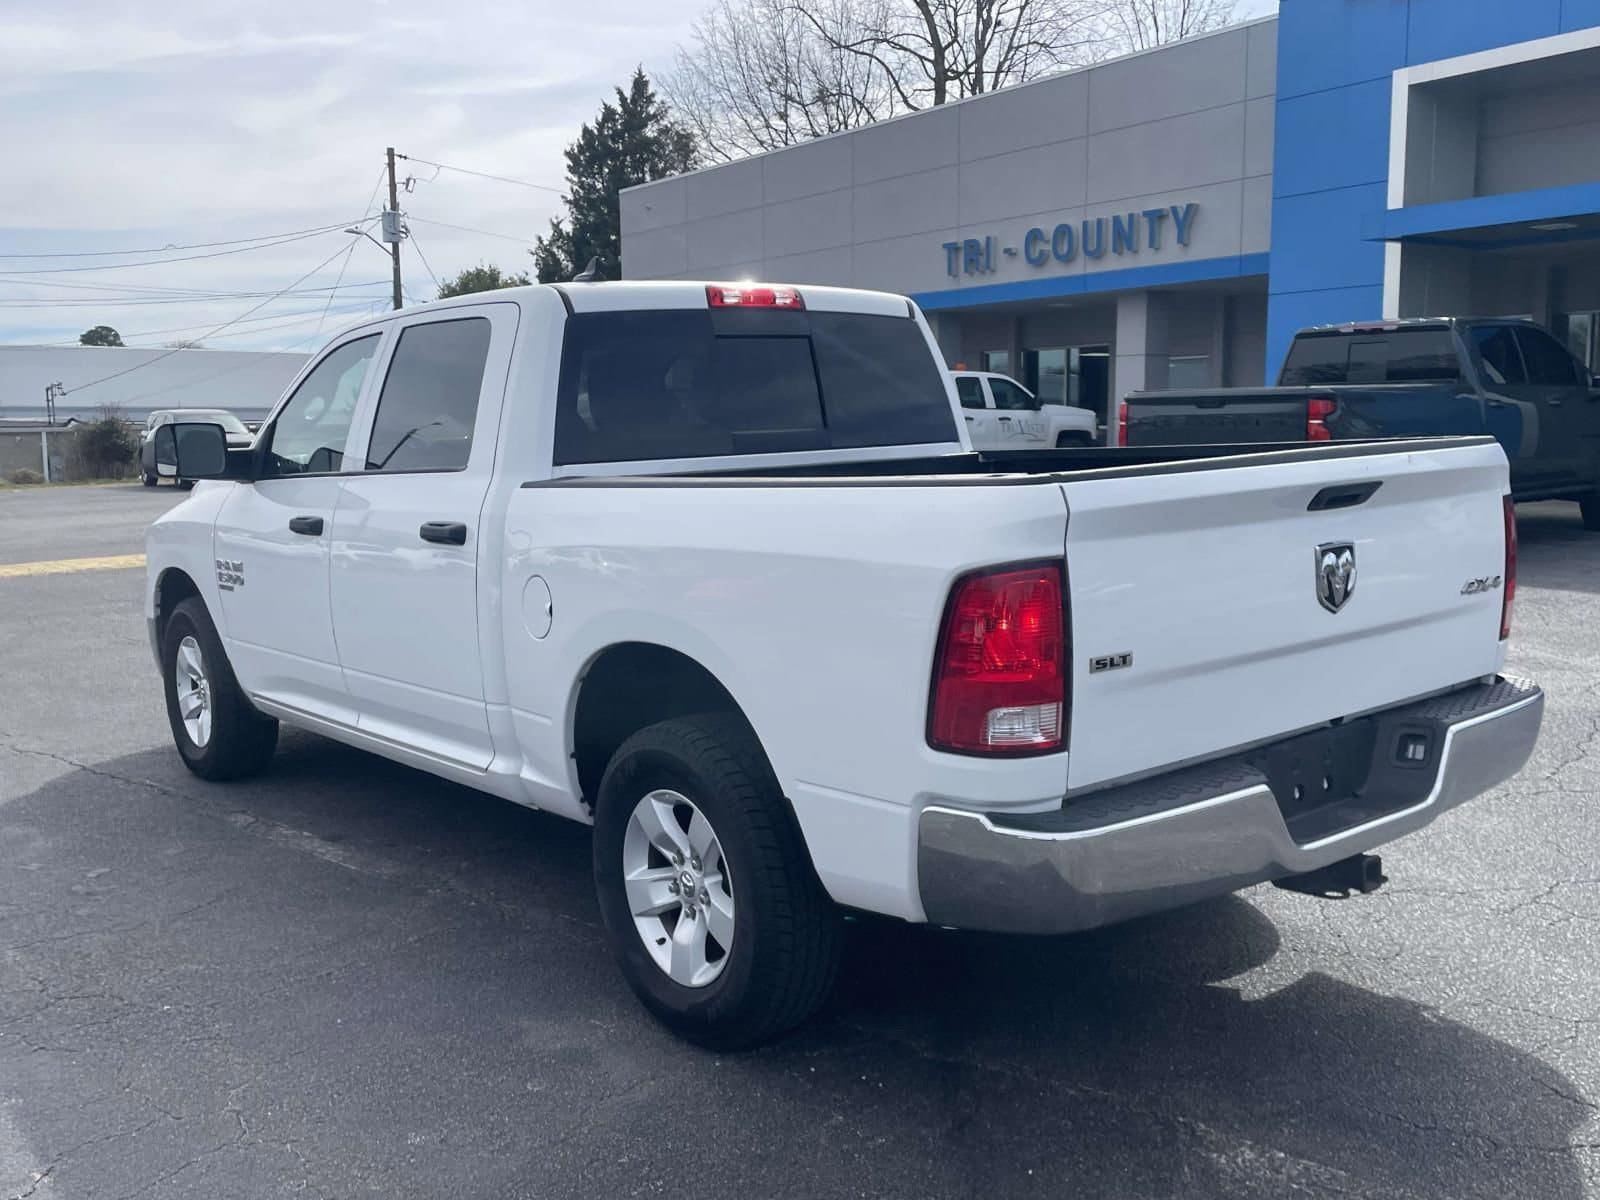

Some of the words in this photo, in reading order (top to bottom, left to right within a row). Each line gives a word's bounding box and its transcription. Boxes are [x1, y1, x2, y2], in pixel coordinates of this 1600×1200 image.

[942, 235, 996, 278] TRI
[1024, 203, 1199, 267] COUNTY
[1094, 653, 1131, 670] SLT
